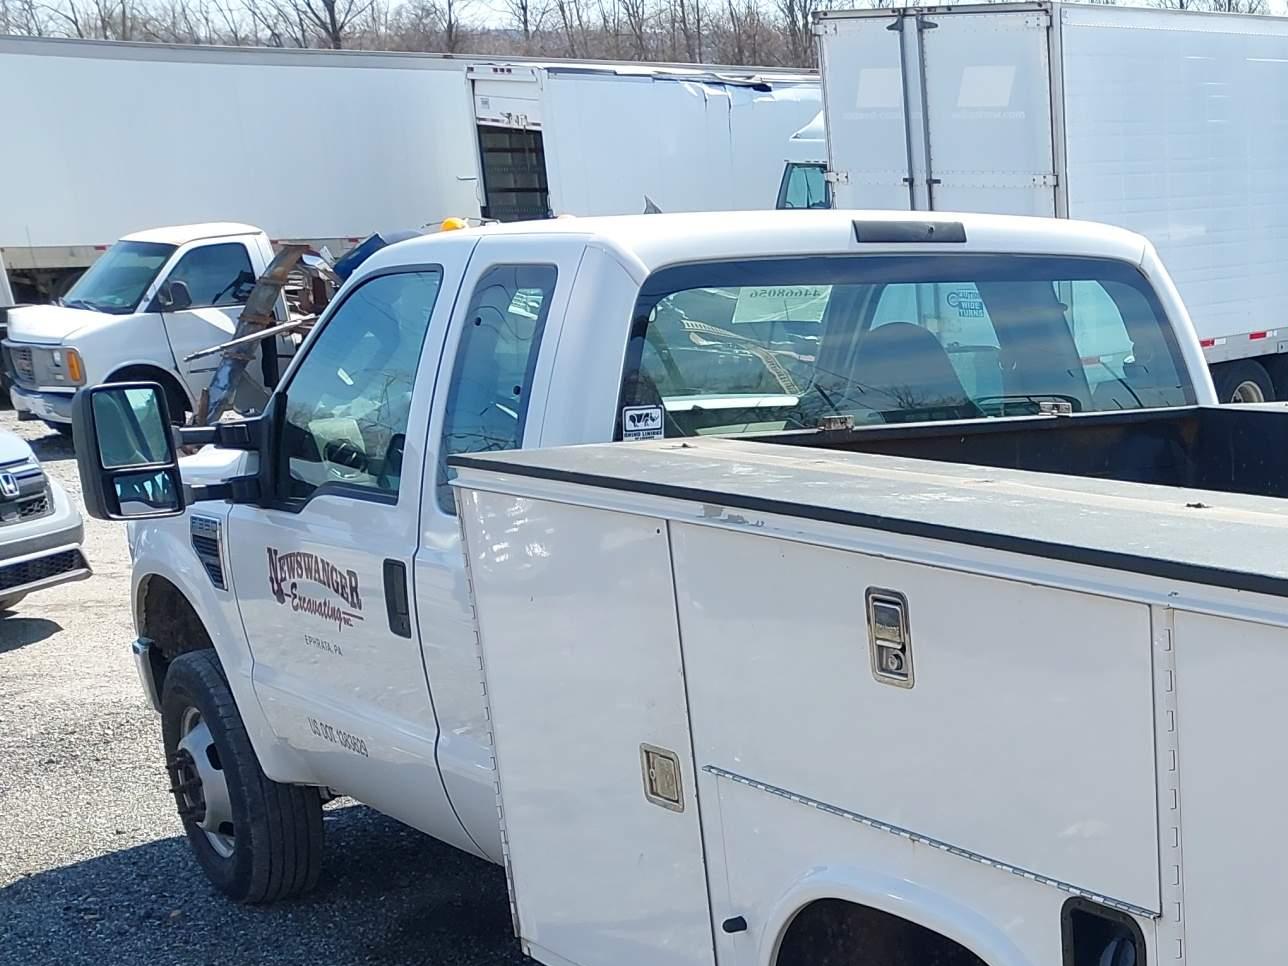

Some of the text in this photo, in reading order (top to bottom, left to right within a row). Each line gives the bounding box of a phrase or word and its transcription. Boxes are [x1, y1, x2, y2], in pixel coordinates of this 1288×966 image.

[960, 301, 982, 310] WIDE
[266, 546, 363, 611] NEWSWANGER
[290, 581, 342, 632] Excavating
[333, 643, 343, 657] PA
[307, 716, 322, 737] US
[319, 721, 337, 744] DOT
